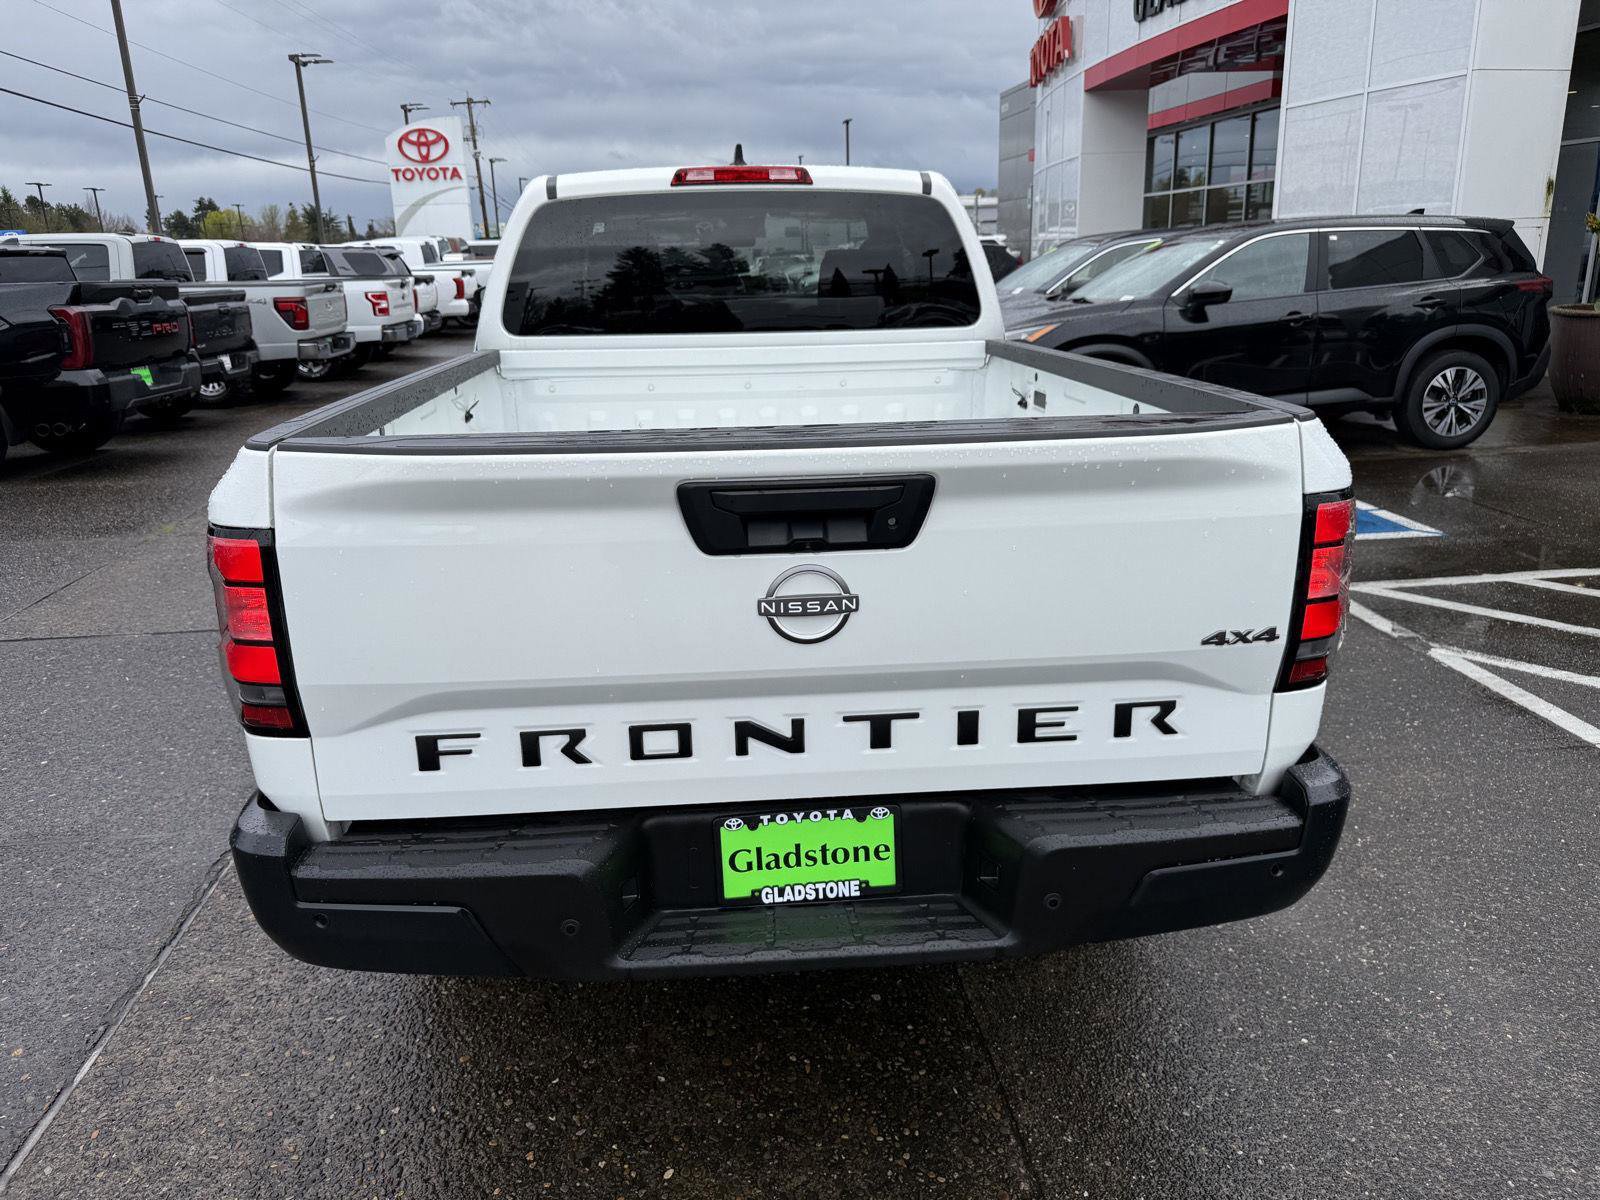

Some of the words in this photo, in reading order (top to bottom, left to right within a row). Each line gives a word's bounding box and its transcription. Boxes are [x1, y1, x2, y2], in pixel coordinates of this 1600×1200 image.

[1029, 15, 1073, 88] OYOTA
[391, 166, 463, 182] TOYOTA
[152, 320, 180, 335] PRO
[760, 598, 857, 614] NISSAN
[415, 699, 1179, 772] FRONTIER
[760, 808, 854, 826] TOYOTA
[728, 842, 891, 873] Gladstone
[761, 880, 861, 904] GLADSTONE
